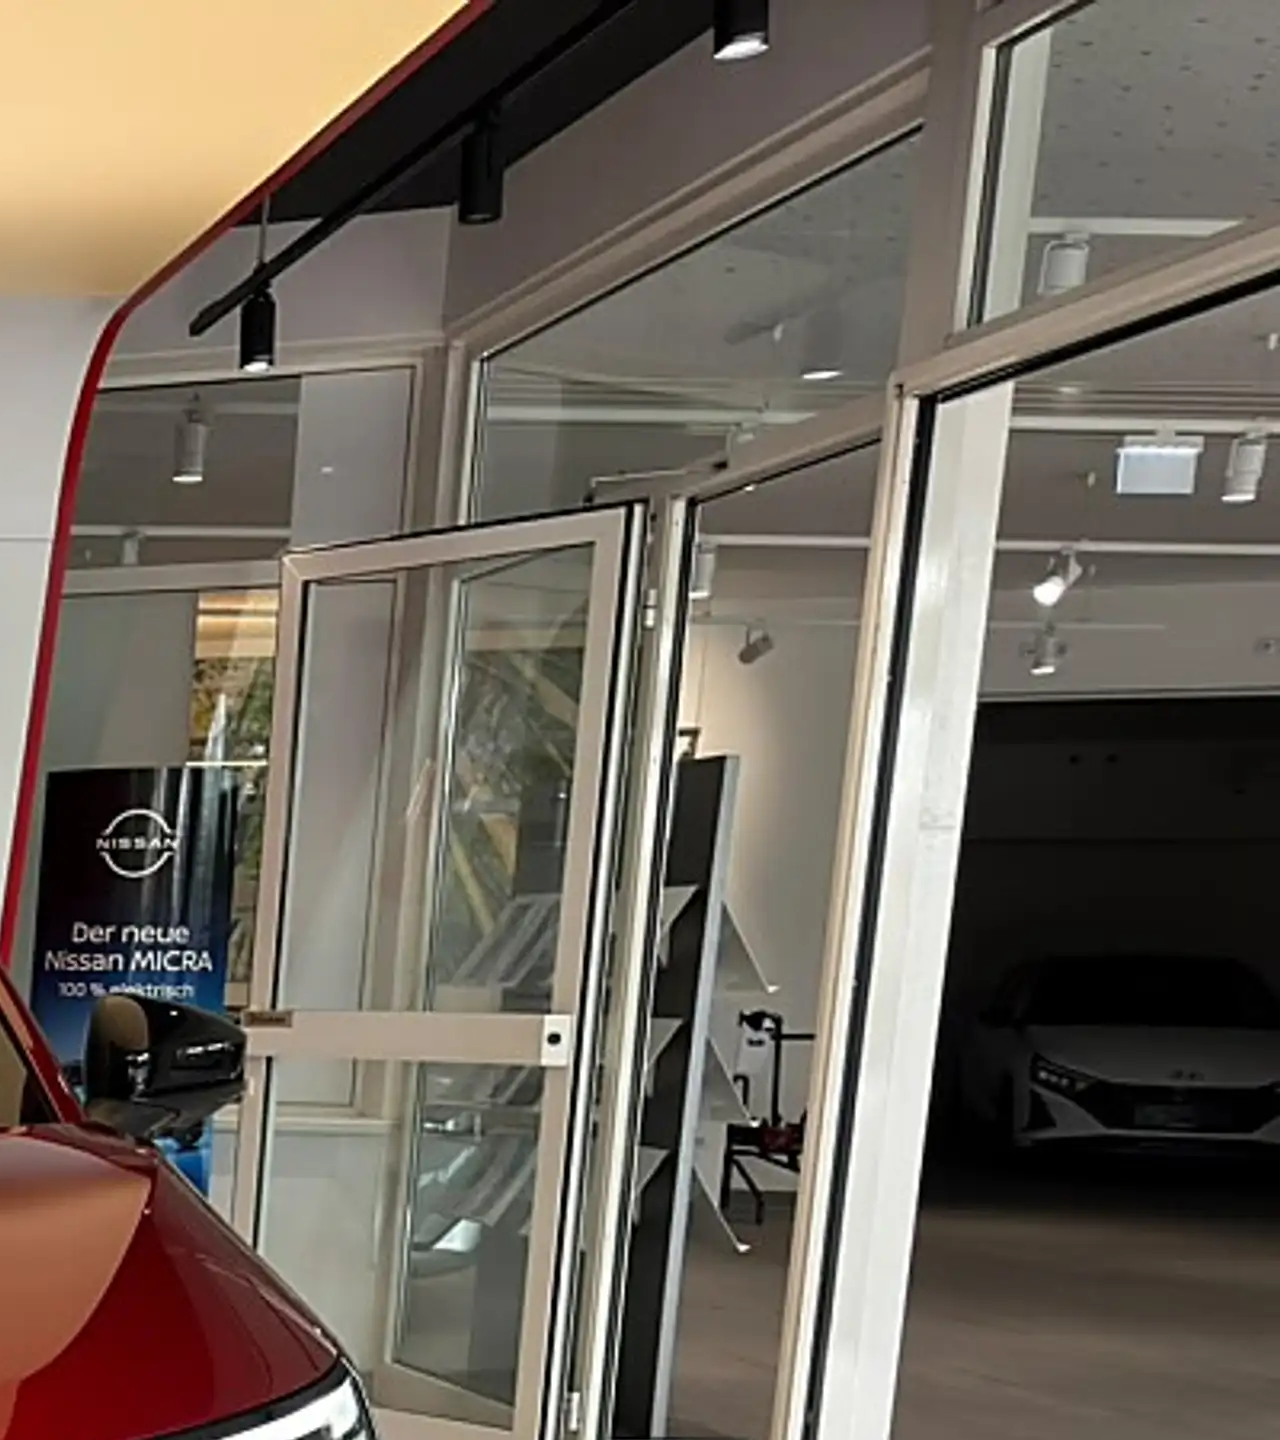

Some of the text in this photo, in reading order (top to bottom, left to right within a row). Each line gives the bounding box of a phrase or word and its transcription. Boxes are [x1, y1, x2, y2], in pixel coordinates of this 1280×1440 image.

[96, 836, 180, 850] NISSAN
[72, 921, 190, 944] Der neue
[44, 950, 213, 972] Nissan MICRA
[58, 982, 88, 997] 100
[90, 982, 107, 997] %
